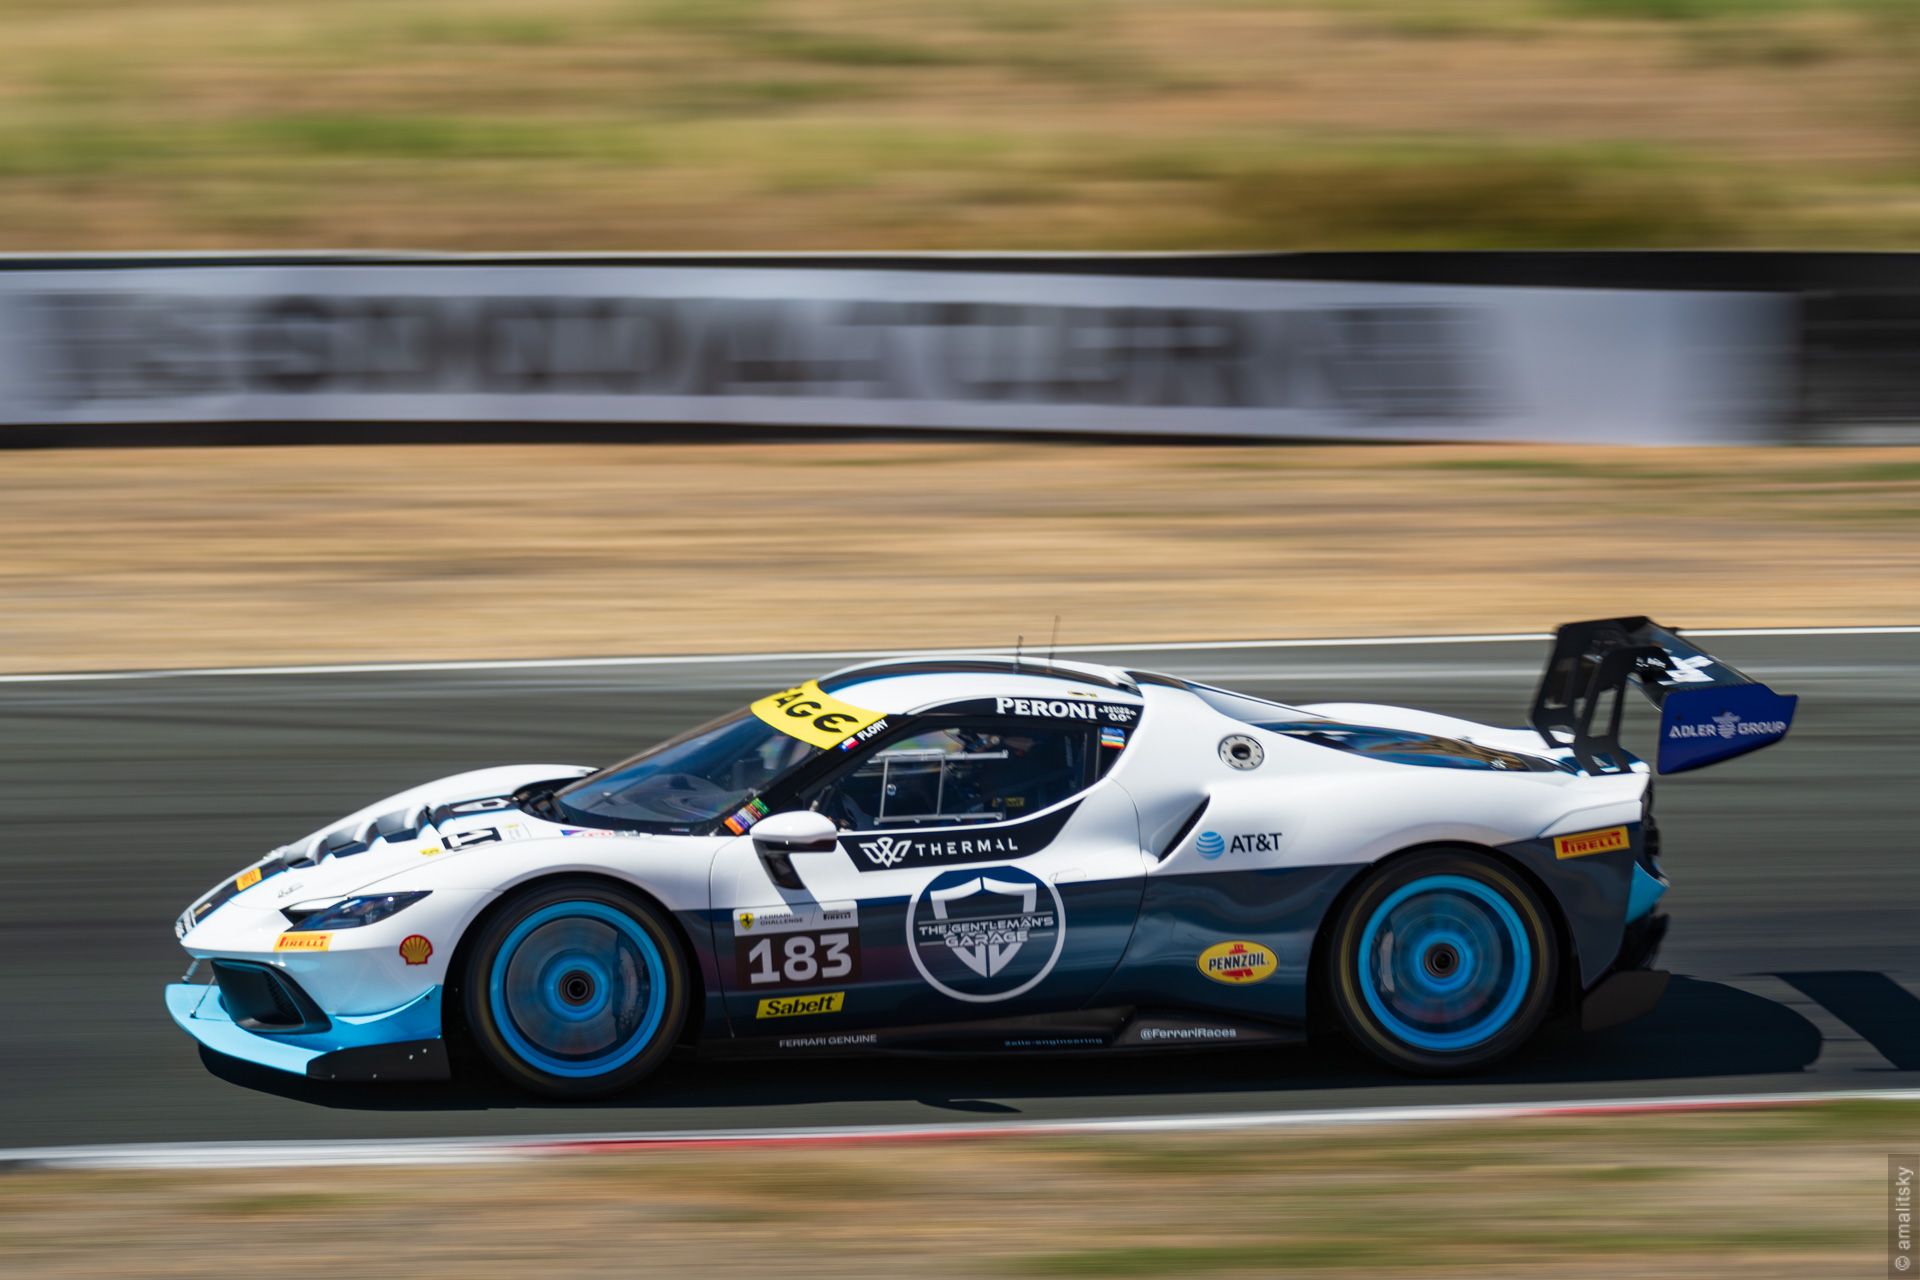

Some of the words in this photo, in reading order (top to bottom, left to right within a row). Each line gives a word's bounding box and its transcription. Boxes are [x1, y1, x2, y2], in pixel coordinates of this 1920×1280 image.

[995, 697, 1098, 720] PERONI
[1669, 724, 1717, 739] ADLER
[1736, 721, 1787, 736] GROUP
[914, 837, 1019, 857] THERMAL
[1230, 832, 1283, 853] AT&T
[1560, 831, 1621, 854] PIRELLI
[919, 924, 947, 936] THE
[950, 916, 1054, 934] GENTLEMAN'S
[278, 935, 328, 948] PIRELLI
[944, 930, 1029, 948] GARAGE
[748, 932, 853, 985] 183
[1208, 952, 1267, 972] PENNZOIL
[765, 995, 835, 1016] Sabelt
[778, 1036, 827, 1048] FERRARI
[828, 1034, 878, 1045] GENUINE
[1140, 1027, 1238, 1041] @FerrariRaces
